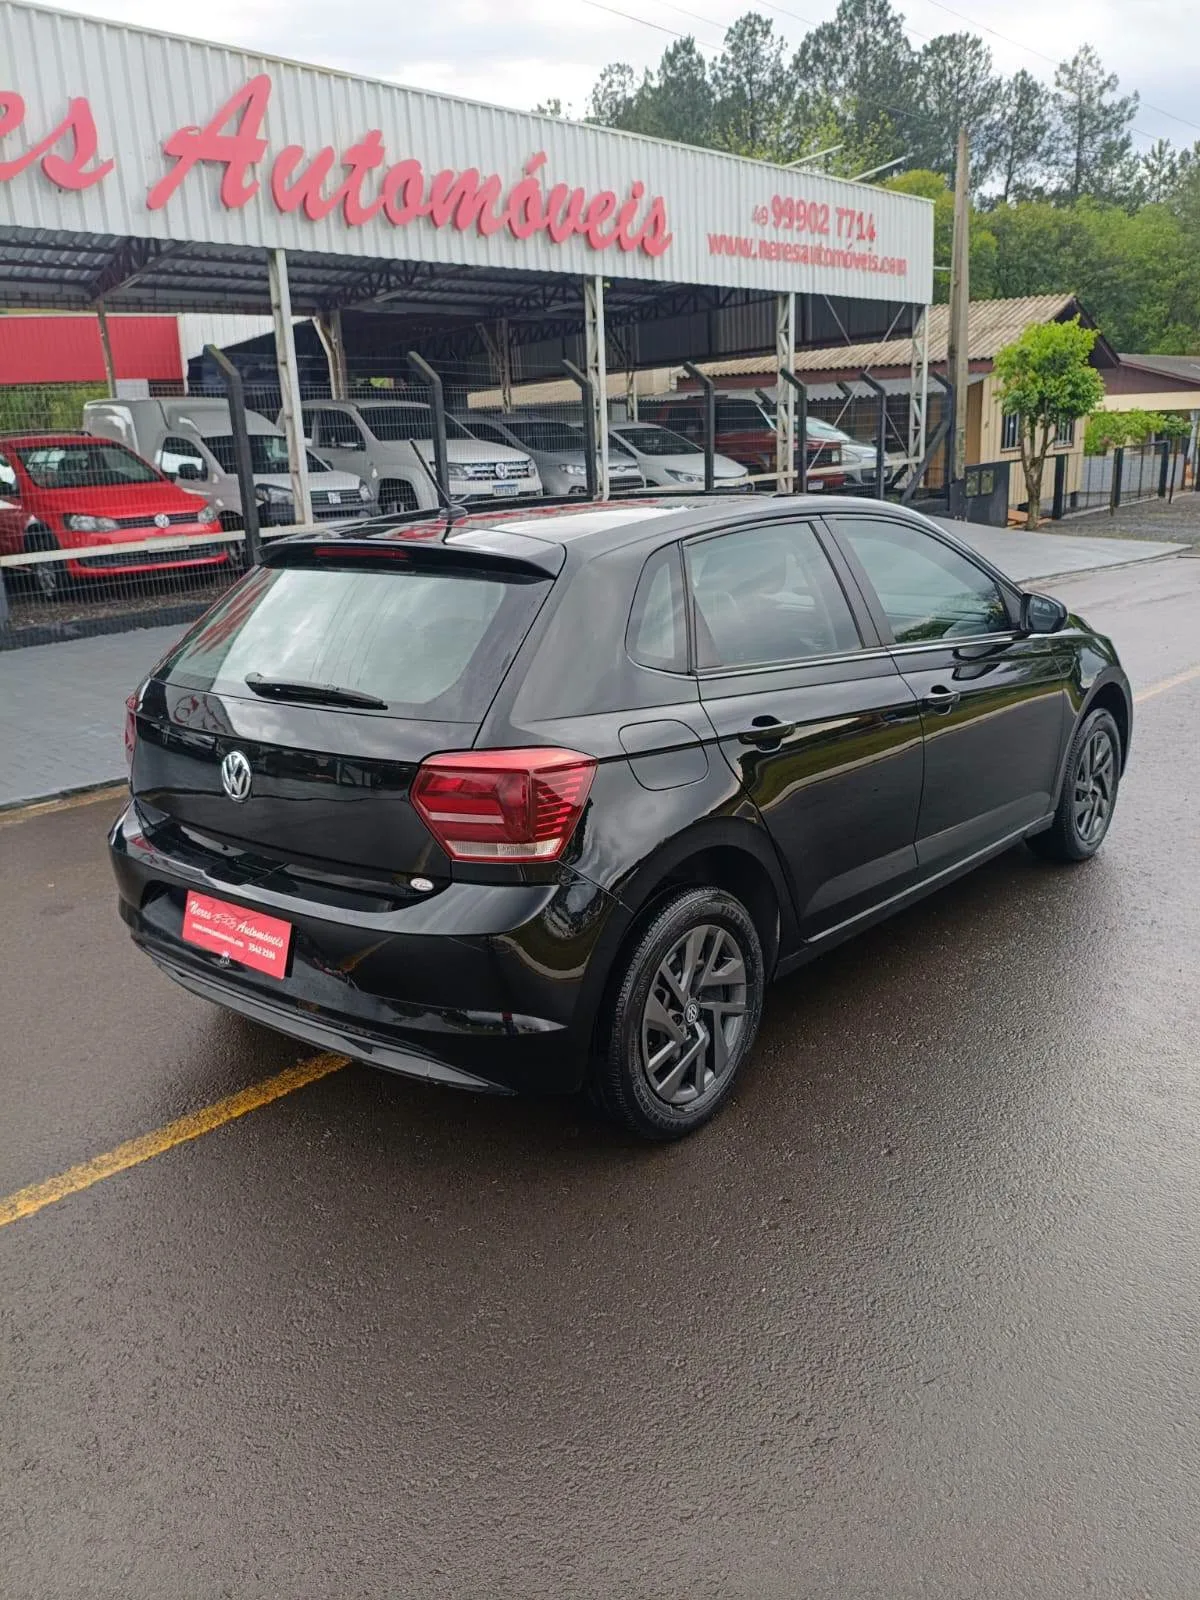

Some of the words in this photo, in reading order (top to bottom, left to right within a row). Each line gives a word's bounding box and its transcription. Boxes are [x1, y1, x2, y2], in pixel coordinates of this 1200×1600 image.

[146, 73, 673, 258] Automóveis
[771, 194, 830, 236] 99902
[835, 206, 877, 242] 7714
